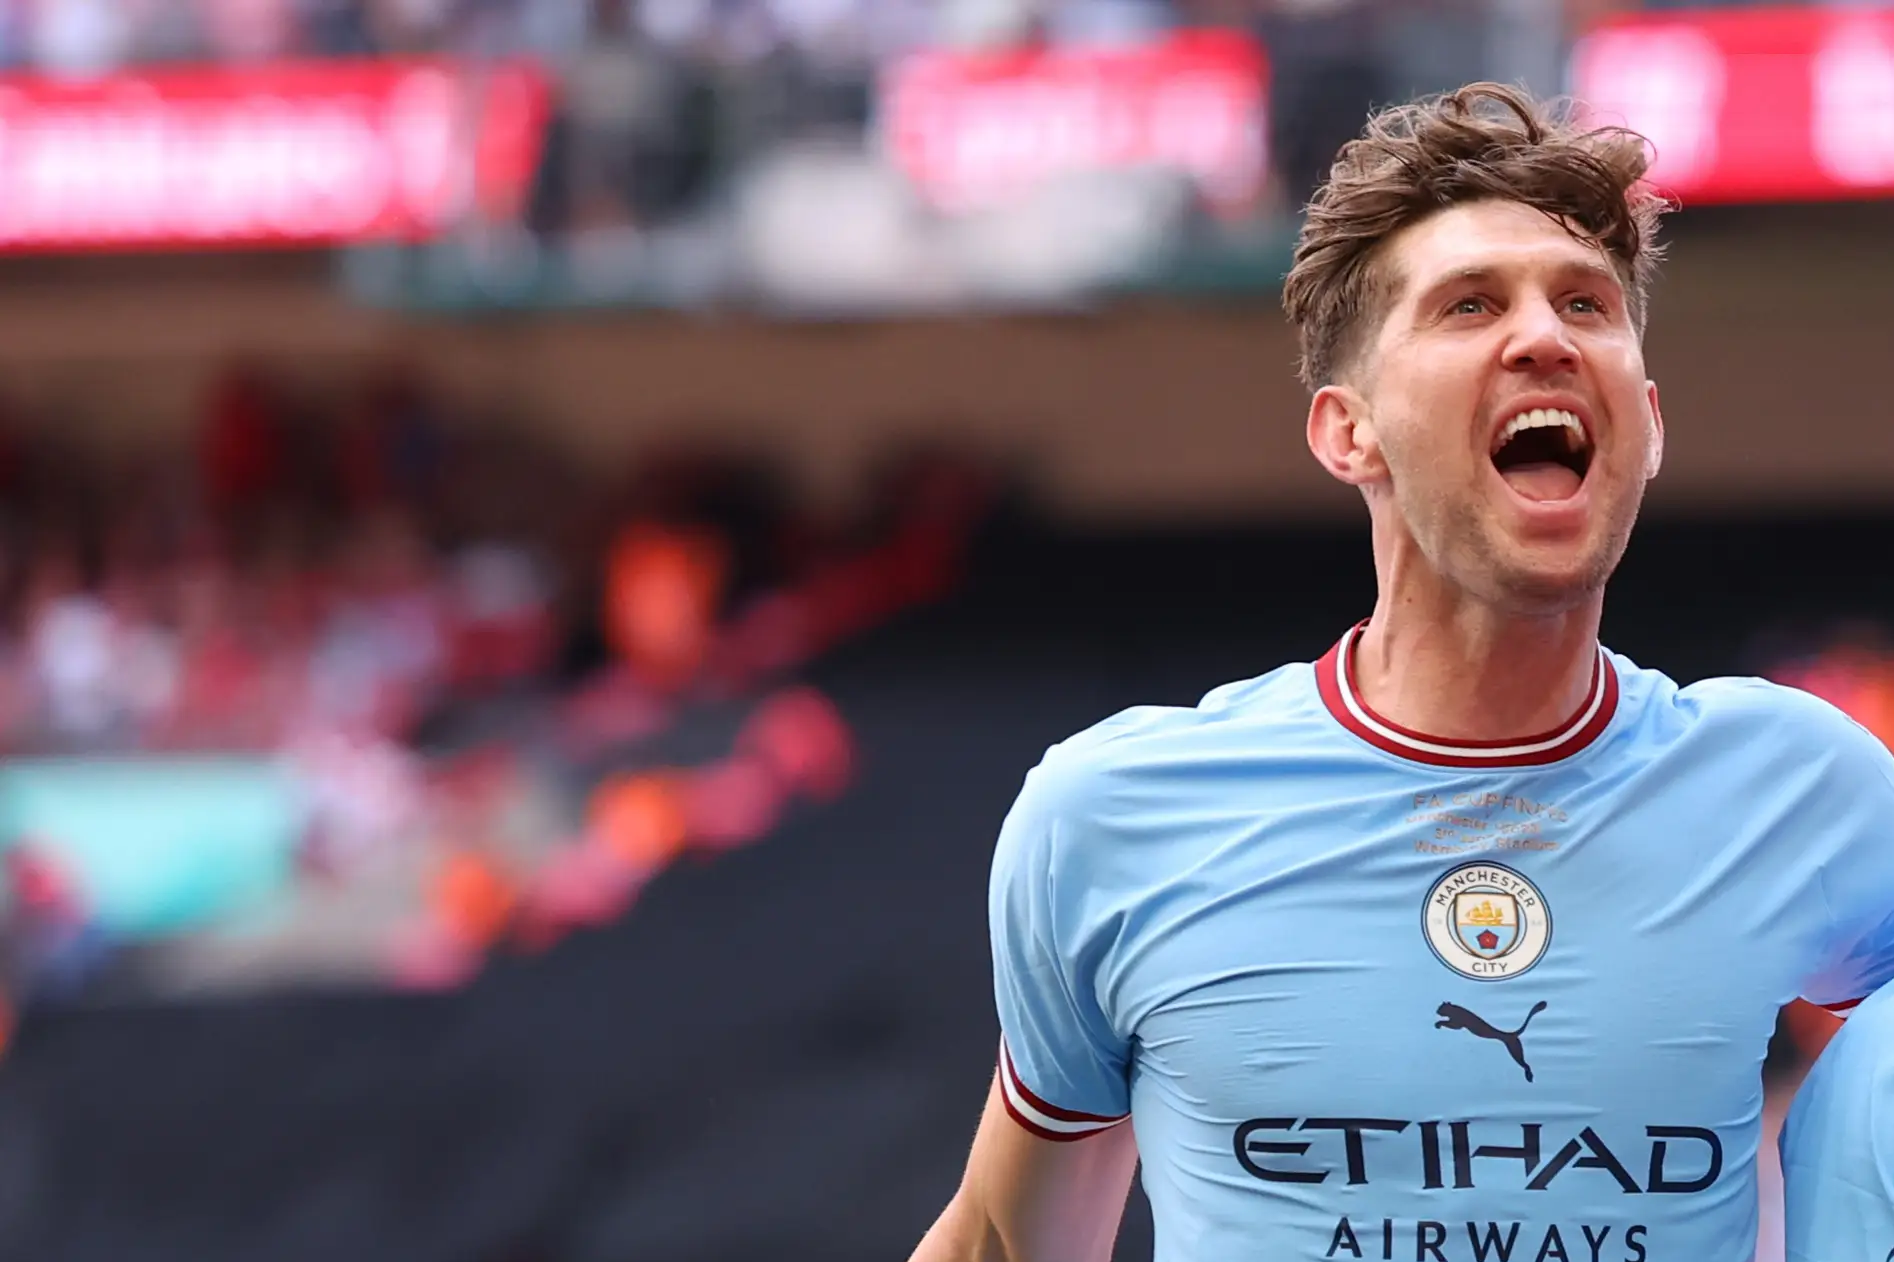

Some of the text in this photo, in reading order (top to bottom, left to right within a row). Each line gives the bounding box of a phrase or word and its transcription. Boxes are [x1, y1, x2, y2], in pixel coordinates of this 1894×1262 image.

[1435, 870, 1537, 909] MANCHESTER
[1471, 961, 1509, 974] CITY
[1232, 1117, 1724, 1195] ETIHAD
